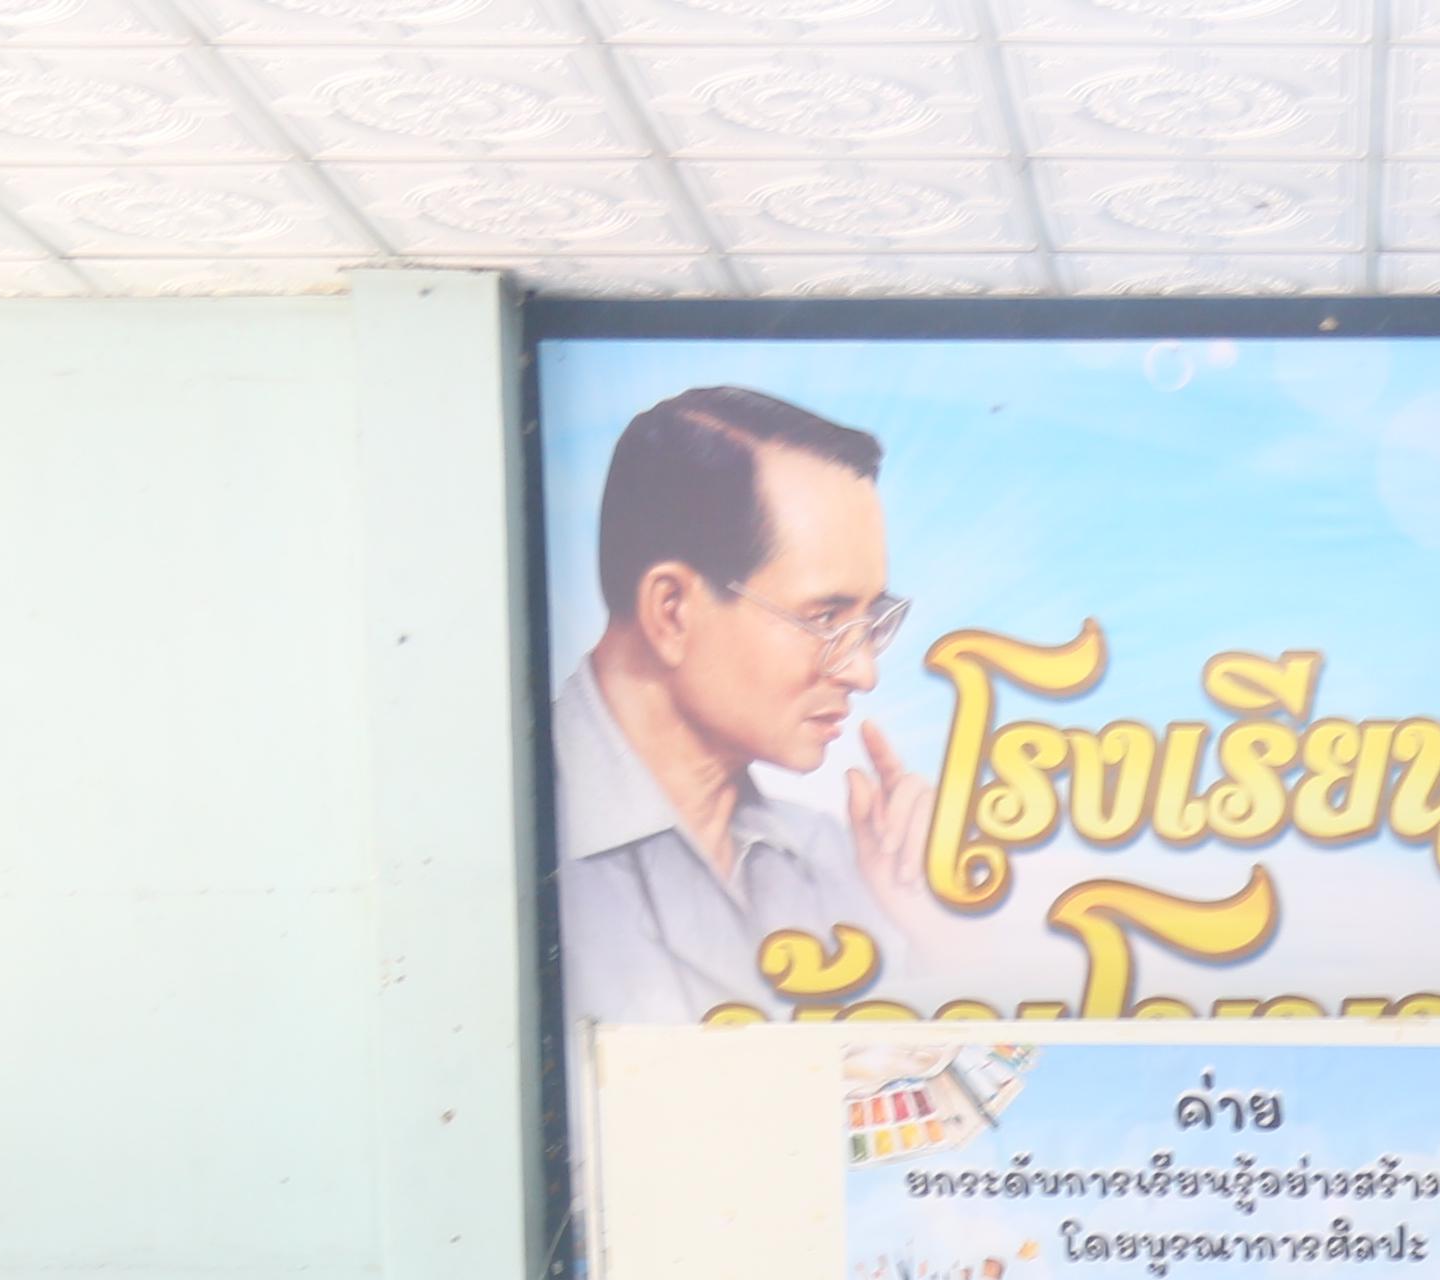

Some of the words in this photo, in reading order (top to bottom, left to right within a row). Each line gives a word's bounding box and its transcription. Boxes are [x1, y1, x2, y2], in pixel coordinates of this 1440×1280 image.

[1175, 1064, 1286, 1133] ค่าย
[1058, 1215, 1432, 1279] โดยบูรณาการศิลปะ
